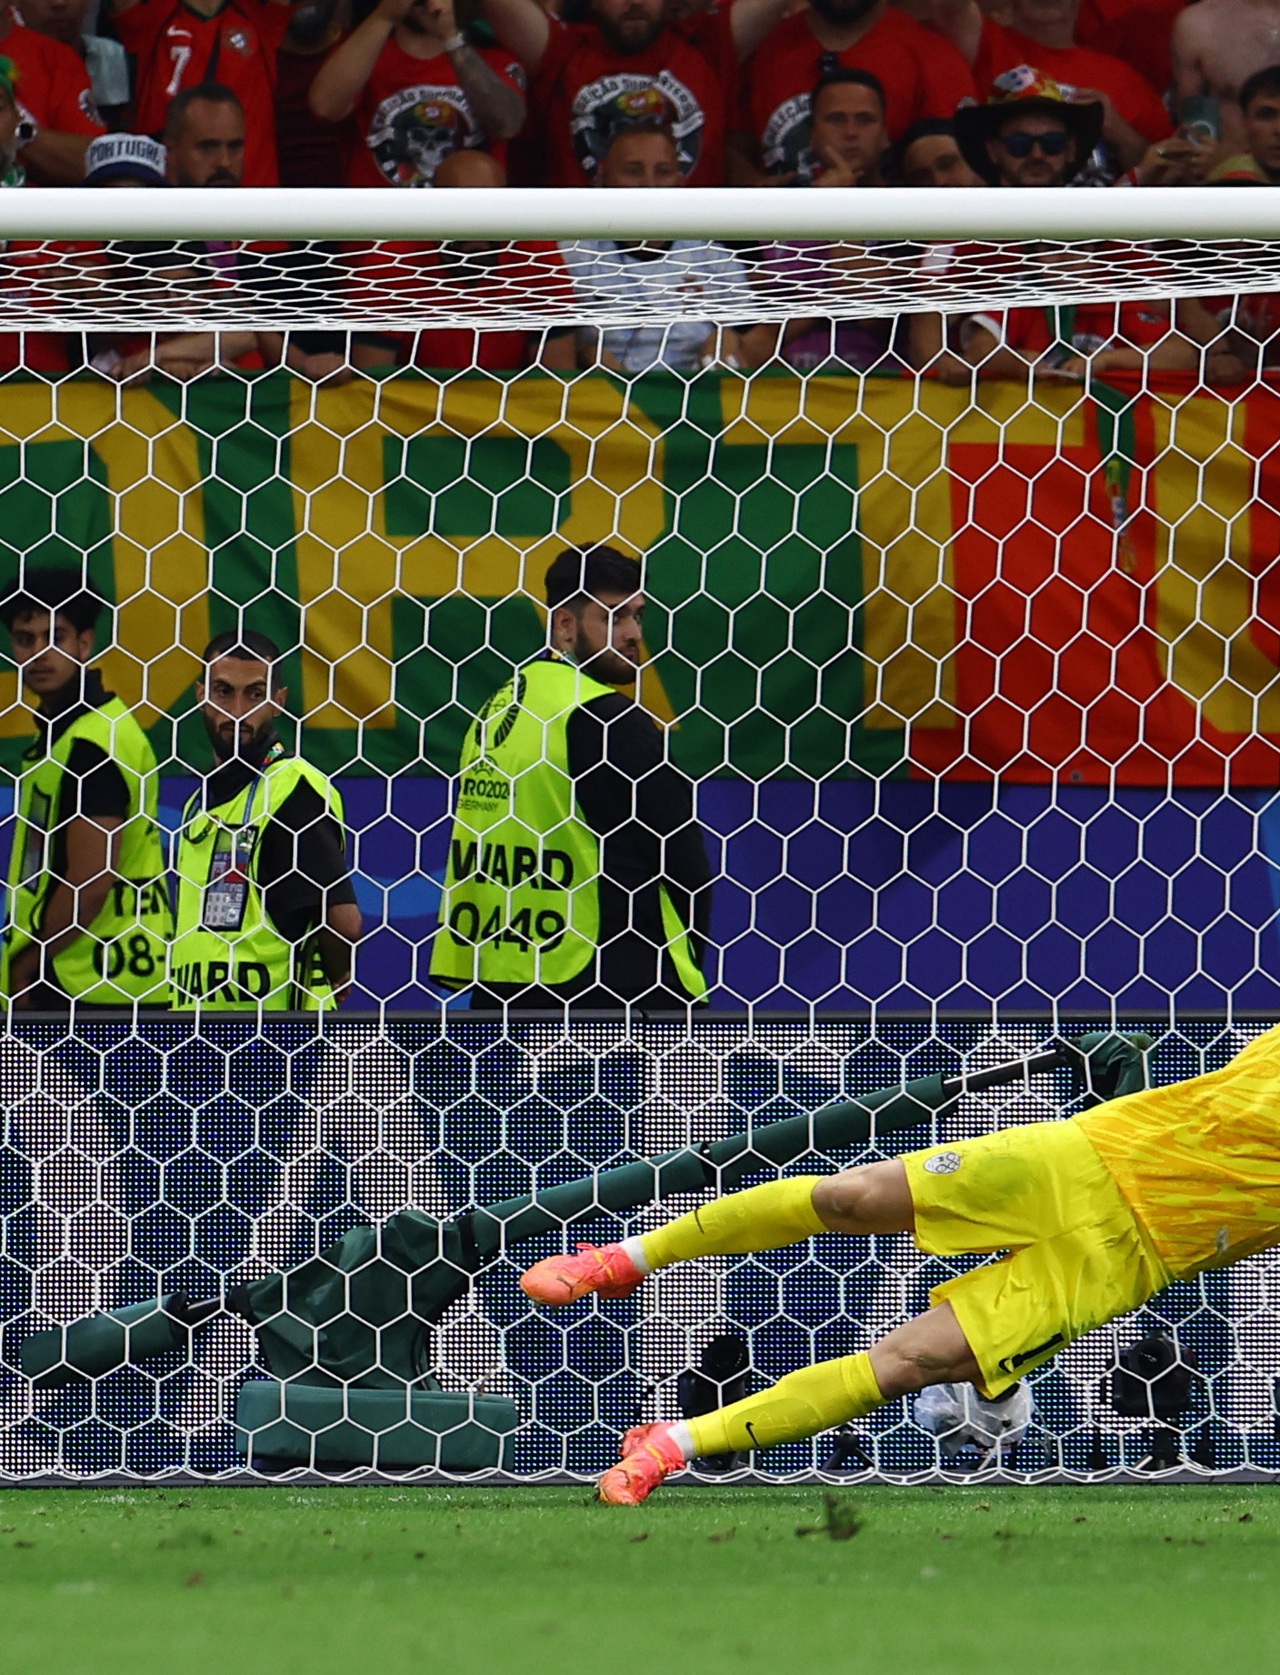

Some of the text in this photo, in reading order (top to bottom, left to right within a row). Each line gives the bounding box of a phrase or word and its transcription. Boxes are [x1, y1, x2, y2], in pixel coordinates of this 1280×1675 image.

[166, 46, 191, 96] 7
[89, 139, 161, 165] PORTUGAL
[463, 777, 516, 800] RO202
[449, 901, 566, 954] 0449
[169, 961, 271, 1009] WARD
